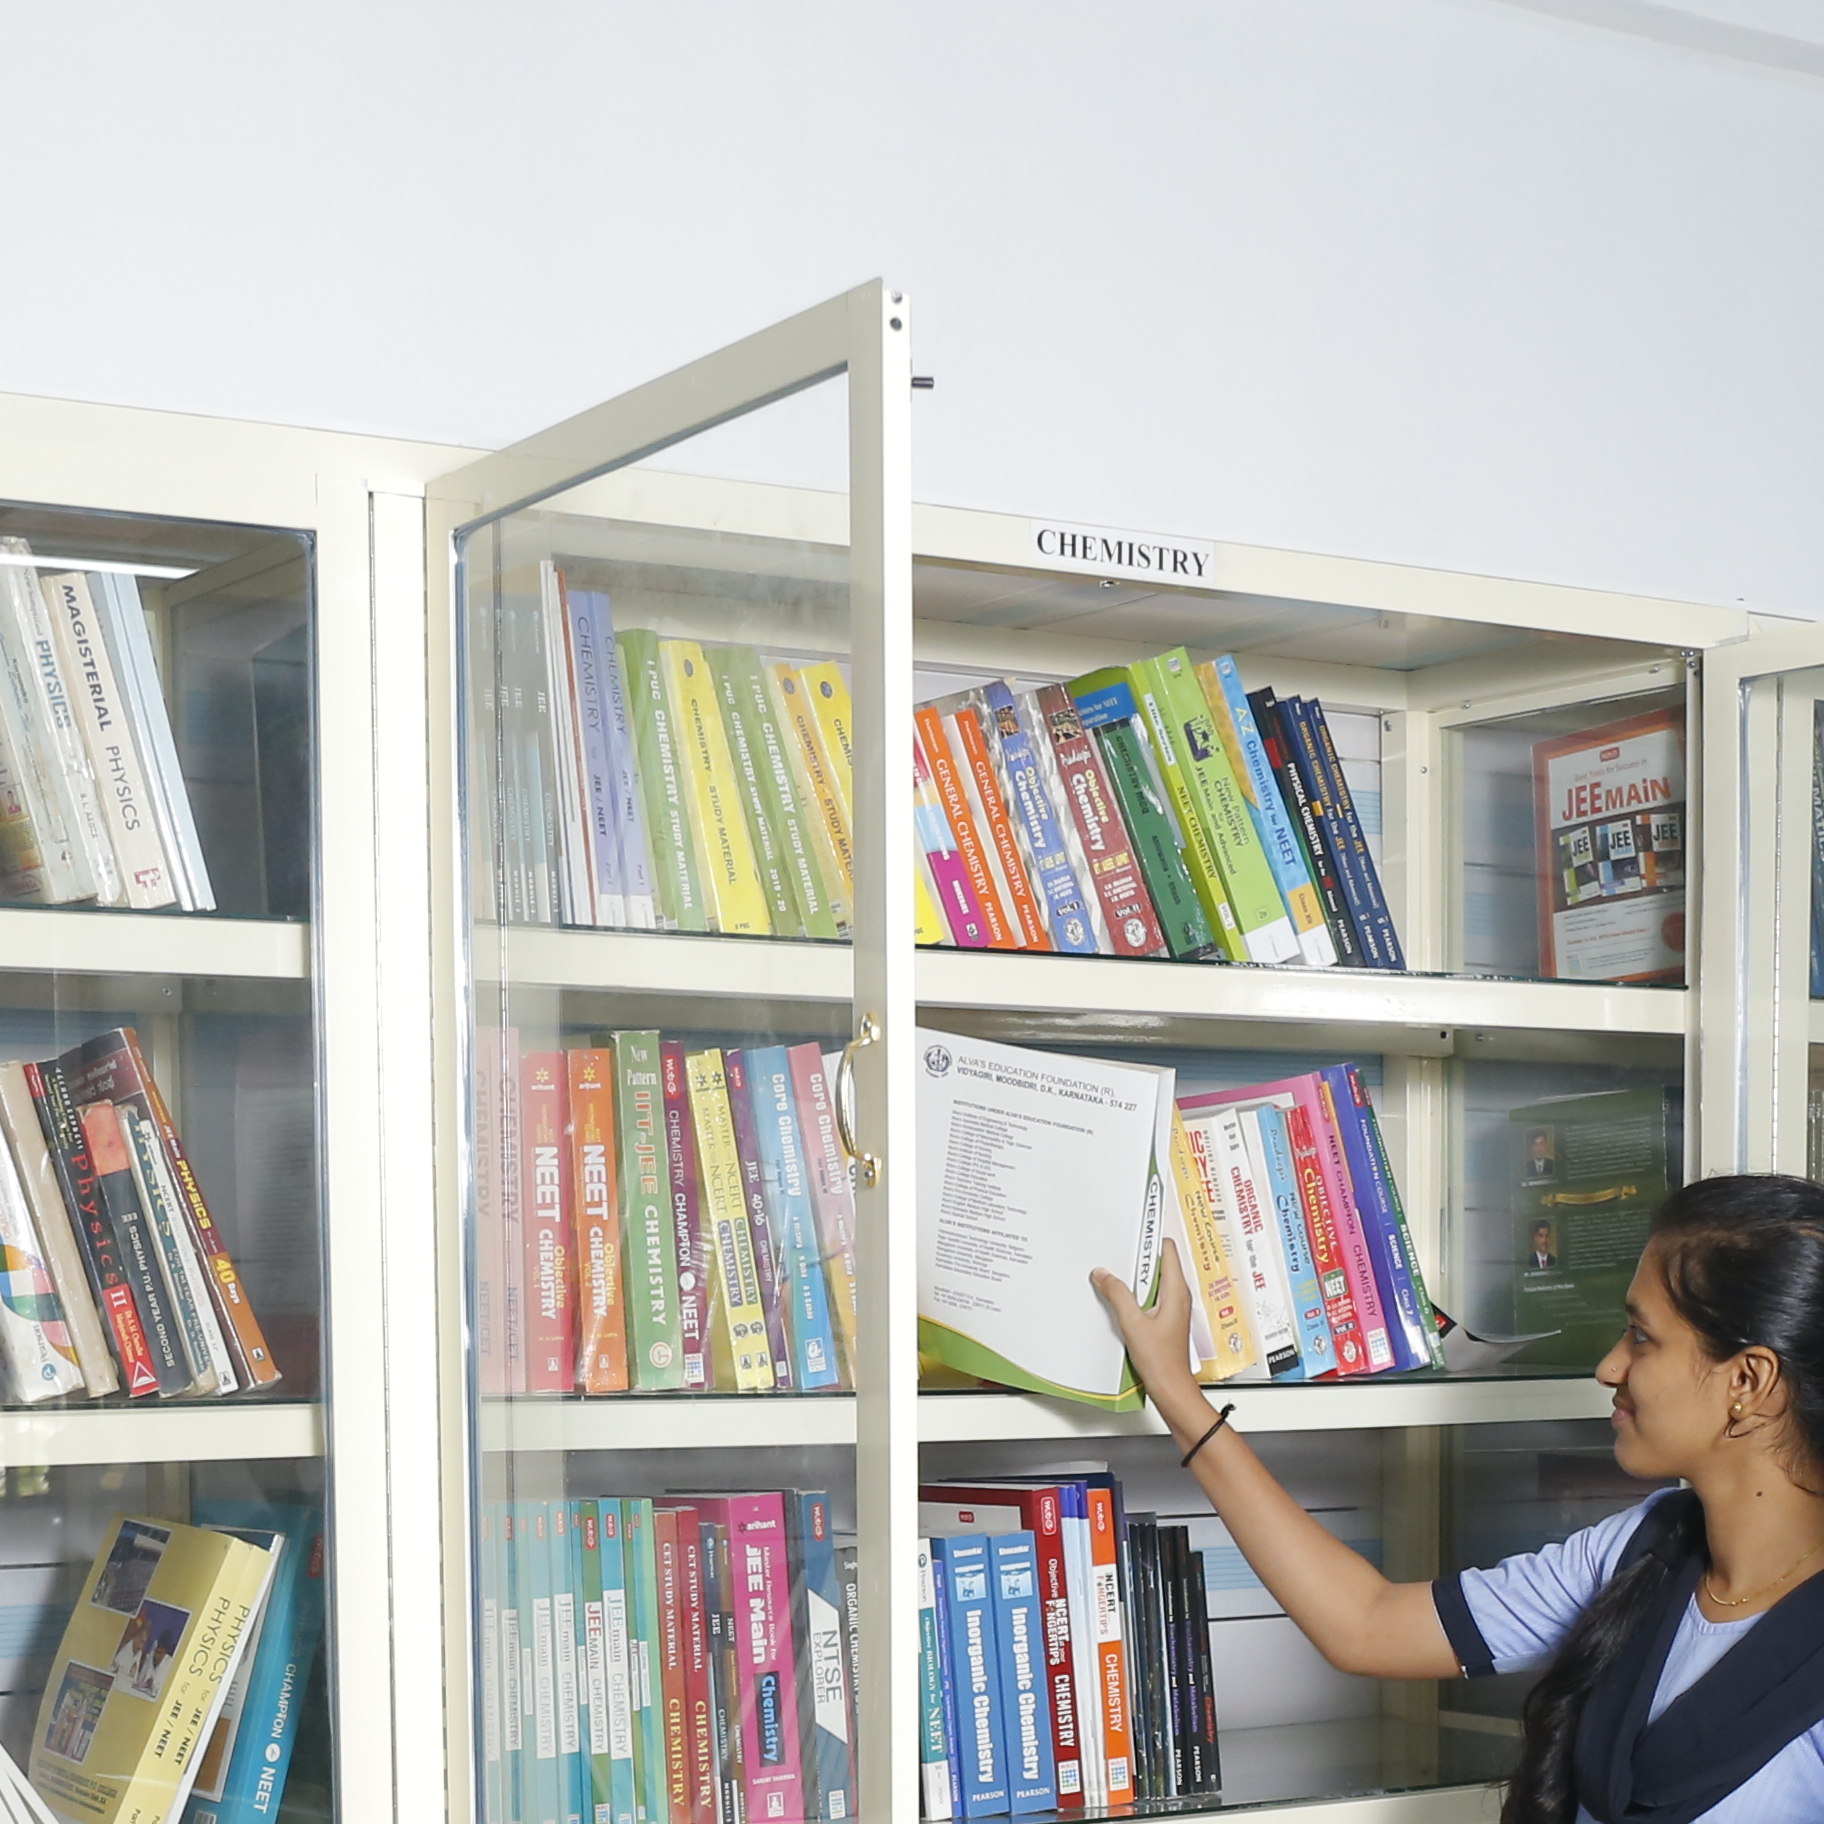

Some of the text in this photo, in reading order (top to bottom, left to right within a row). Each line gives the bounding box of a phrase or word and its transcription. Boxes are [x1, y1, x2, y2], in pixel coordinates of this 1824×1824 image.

[1037, 529, 1209, 577] CHEMISTRY
[60, 583, 141, 833] MAGISTERIAL PHYSICS
[578, 616, 601, 733] CHEMISTRY
[654, 709, 692, 911] CHEMISTRY STUDY MATERIAL
[1177, 786, 1218, 880] NEET CHEMISTRY
[1562, 781, 1603, 822] JEE
[935, 757, 1003, 941] GENERAL CHEMISTRY PEARSON
[627, 1067, 657, 1086] Pattern
[631, 1045, 648, 1062] New
[956, 1067, 994, 1083] VIDYAGIRI,
[1059, 1089, 1104, 1105] KARNATAKA
[1110, 1099, 1123, 1108] 574
[1124, 1102, 1138, 1111] 227
[957, 1056, 986, 1070] ALVA'S
[987, 1062, 1039, 1081] EDUCATION
[1040, 1074, 1099, 1093] FOUNDATION
[771, 1073, 802, 1197] Core Chemistry
[534, 1147, 561, 1222] NEET
[644, 1205, 667, 1326] CHEMISTRY
[1138, 1181, 1159, 1287] CHEMISTRY
[539, 1229, 557, 1320] CHEMISTRY
[1267, 1348, 1296, 1367] PEARSON
[744, 1544, 767, 1664] JEE Main
[812, 1632, 826, 1705] EXPLORER
[822, 1630, 843, 1701] NTSE
[966, 1609, 994, 1783] Inorganic Chemistry
[1104, 1654, 1123, 1733] CHEMISTRY
[759, 1675, 778, 1762] Chemistry
[253, 1766, 277, 1815] NEET
[972, 1790, 1004, 1801] PEARSON
